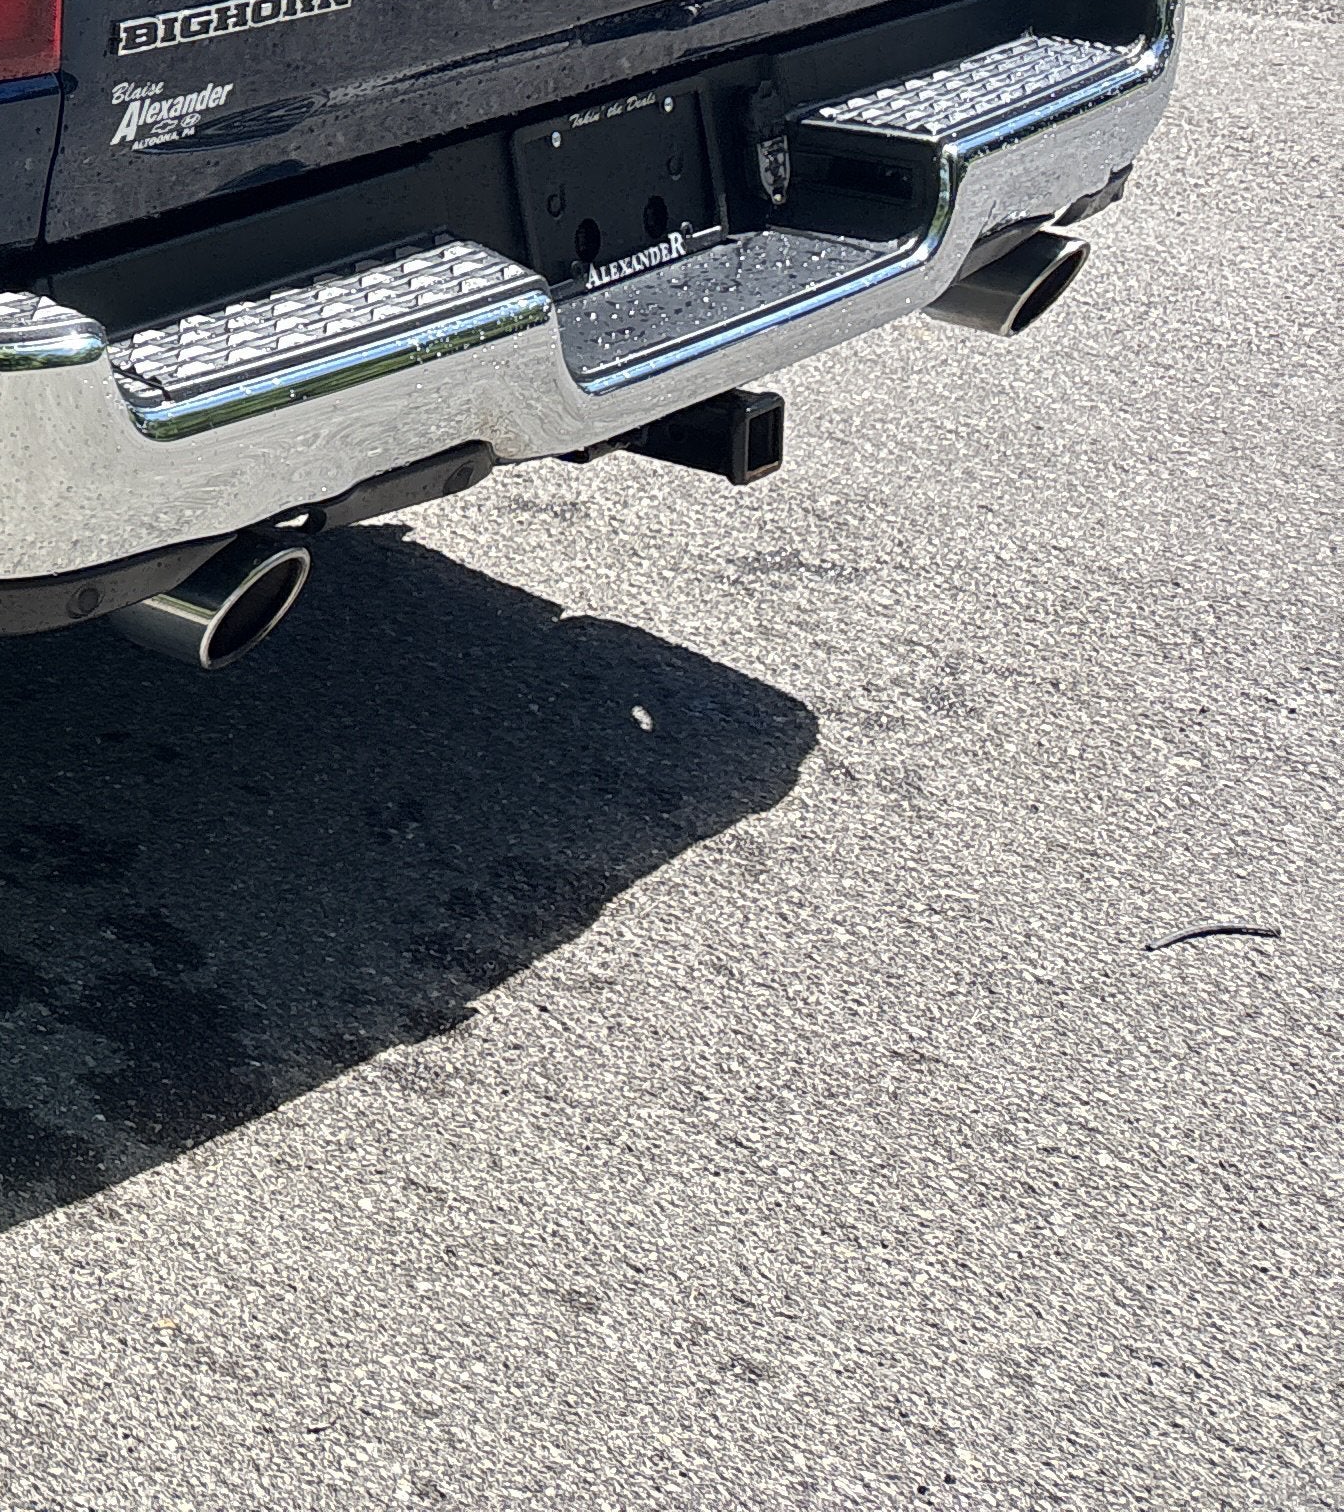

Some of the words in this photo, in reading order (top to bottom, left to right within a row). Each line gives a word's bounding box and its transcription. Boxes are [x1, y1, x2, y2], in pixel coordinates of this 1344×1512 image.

[111, 81, 165, 105] Blaise
[110, 82, 233, 146] Alexander
[607, 103, 624, 118] the
[181, 126, 196, 138] PA
[585, 231, 687, 289] ALEXANDER
